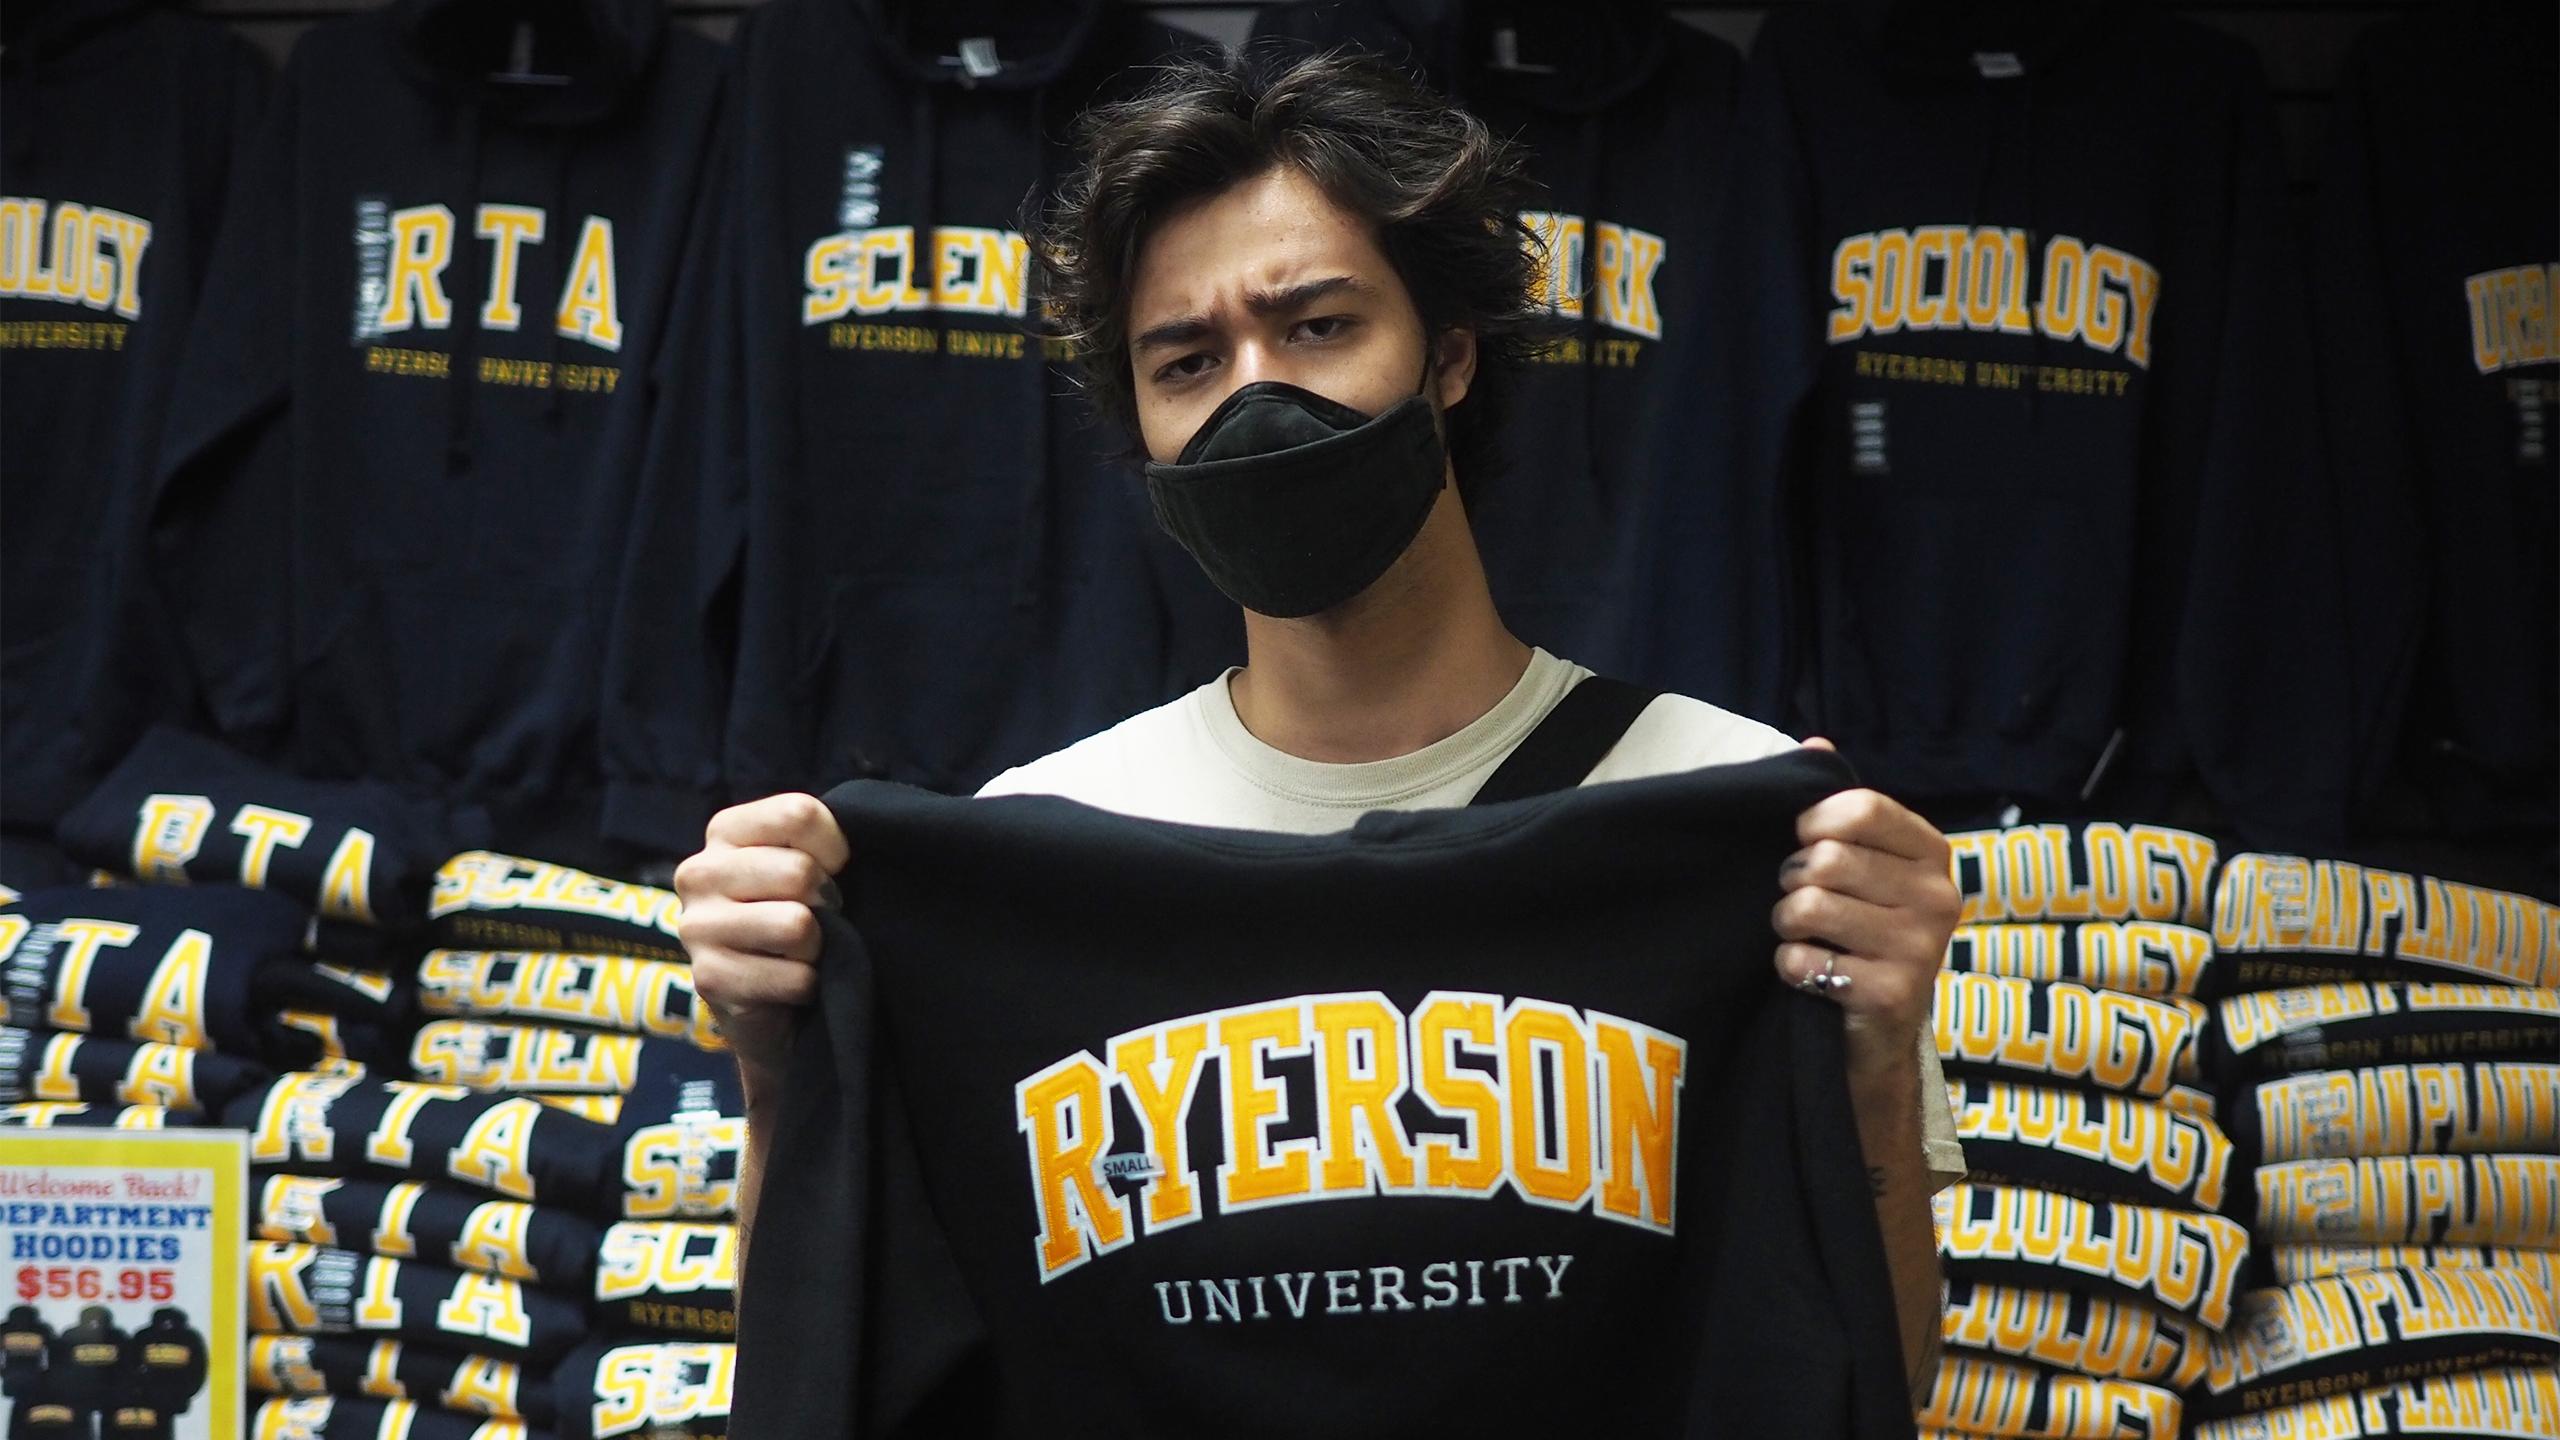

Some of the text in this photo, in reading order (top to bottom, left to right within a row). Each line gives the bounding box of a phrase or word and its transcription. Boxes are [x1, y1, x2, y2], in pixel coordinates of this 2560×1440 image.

[379, 203, 622, 352] RTA
[1826, 225, 2161, 369] SOCIOLOGY
[478, 356, 620, 393] UNIVESITY
[1976, 361, 2130, 396] UNIERSITY
[1015, 990, 1688, 1285] RYERSON
[1103, 1156, 1154, 1177] SMALL
[13, 1233, 181, 1261] HOODIES
[16, 1265, 176, 1303] $56.95
[1155, 1255, 1575, 1325] UNIVERSITY
